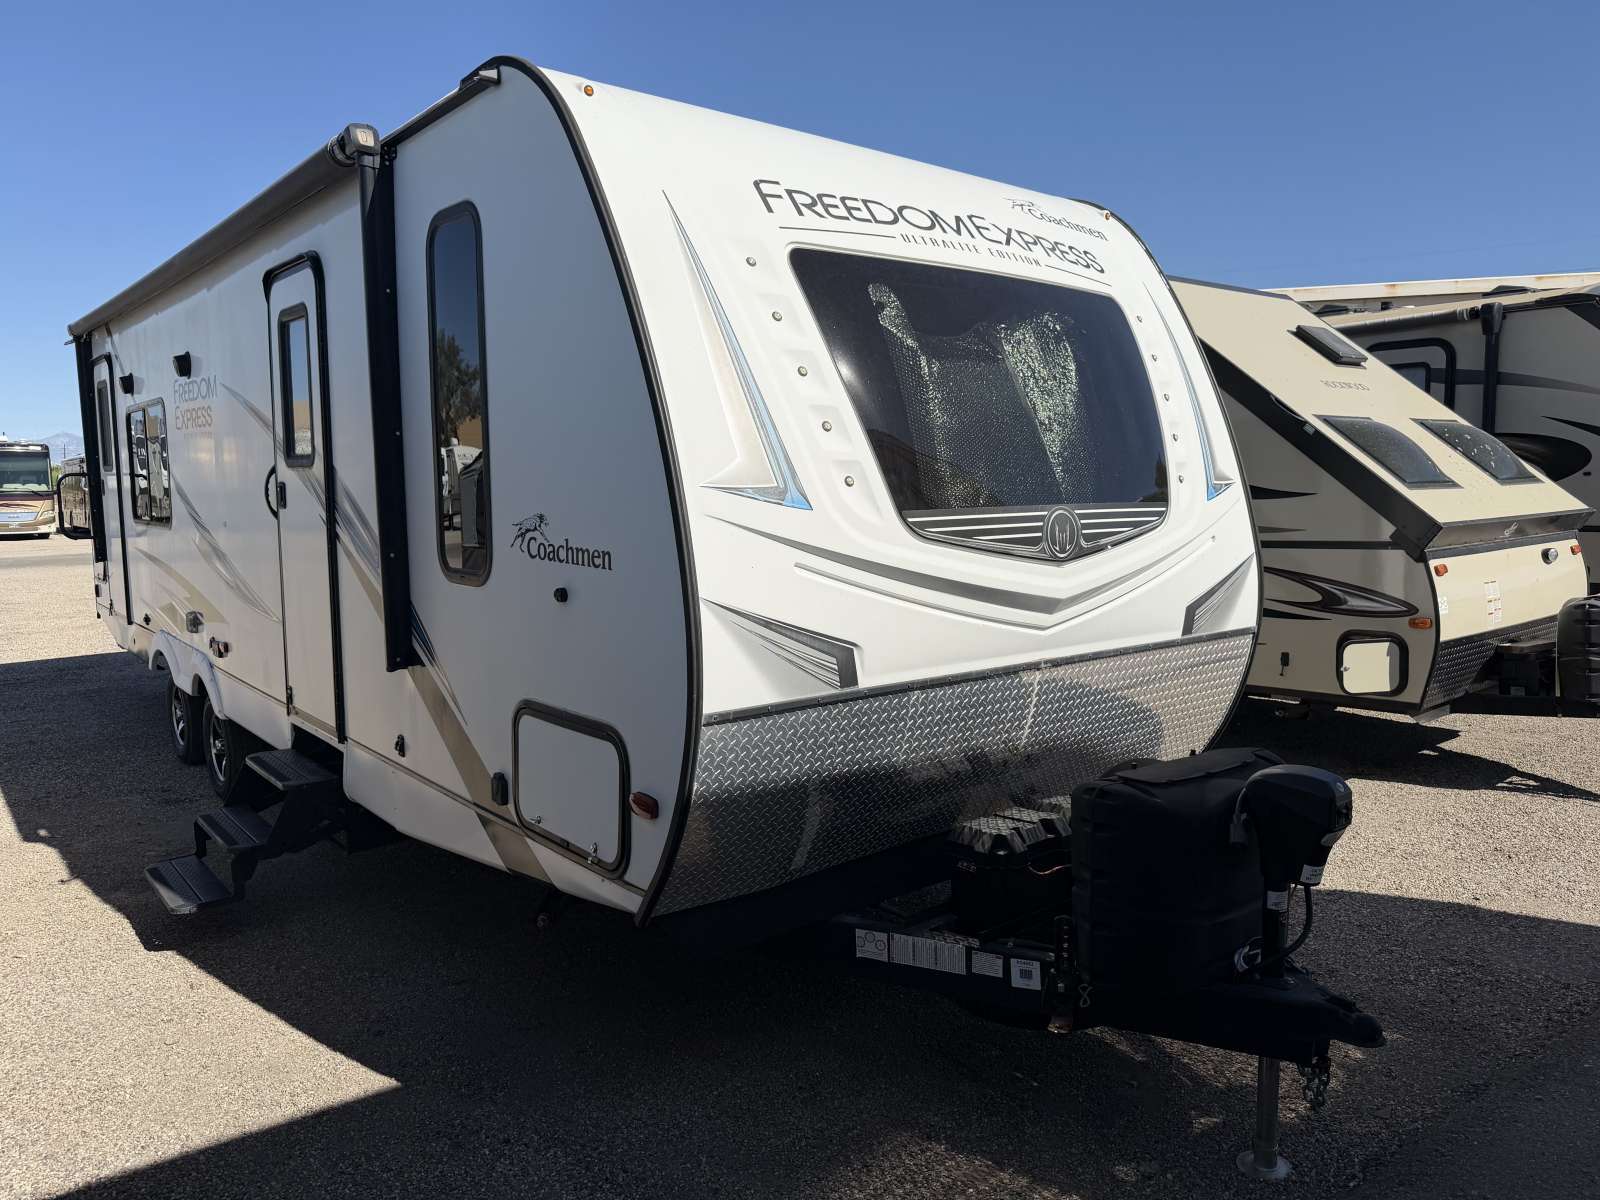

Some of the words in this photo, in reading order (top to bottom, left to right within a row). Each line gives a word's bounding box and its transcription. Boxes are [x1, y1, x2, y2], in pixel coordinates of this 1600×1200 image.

[1028, 208, 1108, 241] Coachmen
[900, 233, 980, 254] ULTRALITE
[987, 247, 1042, 267] EDITION
[173, 375, 217, 404] FREEDOM
[175, 406, 213, 430] EXPRESS
[527, 536, 612, 570] Coachmen
